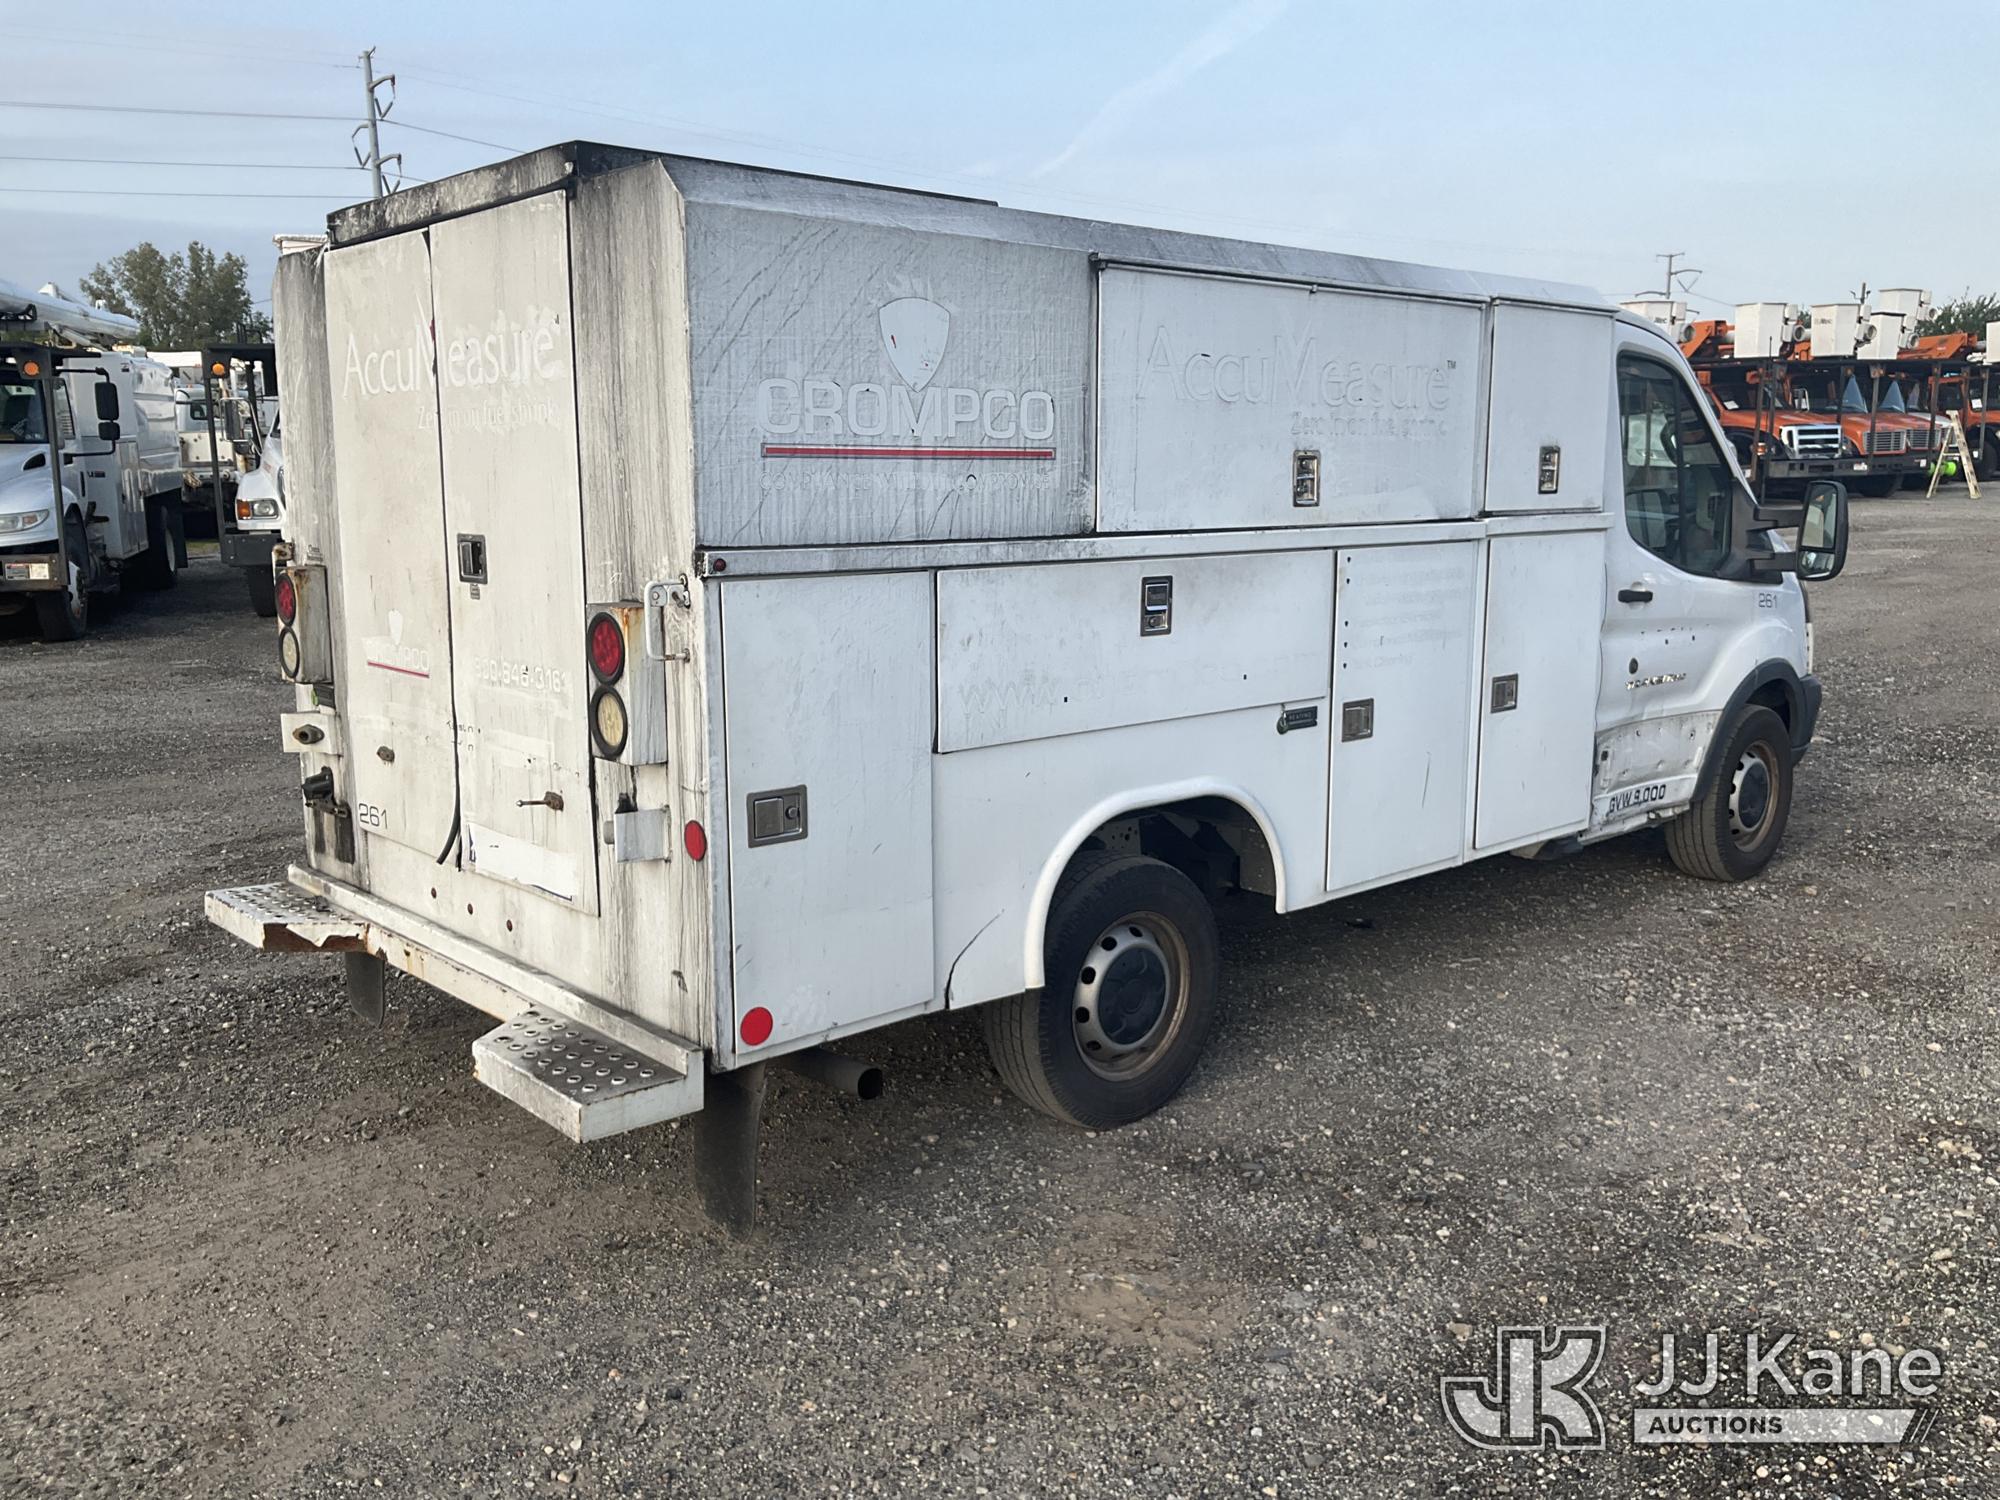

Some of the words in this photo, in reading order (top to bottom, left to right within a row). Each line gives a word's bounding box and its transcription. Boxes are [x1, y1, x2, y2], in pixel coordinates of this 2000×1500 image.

[758, 377, 1055, 440] CROMPCO
[1758, 592, 1778, 608] 261
[1609, 791, 1632, 813] GVW
[358, 803, 389, 829] 261
